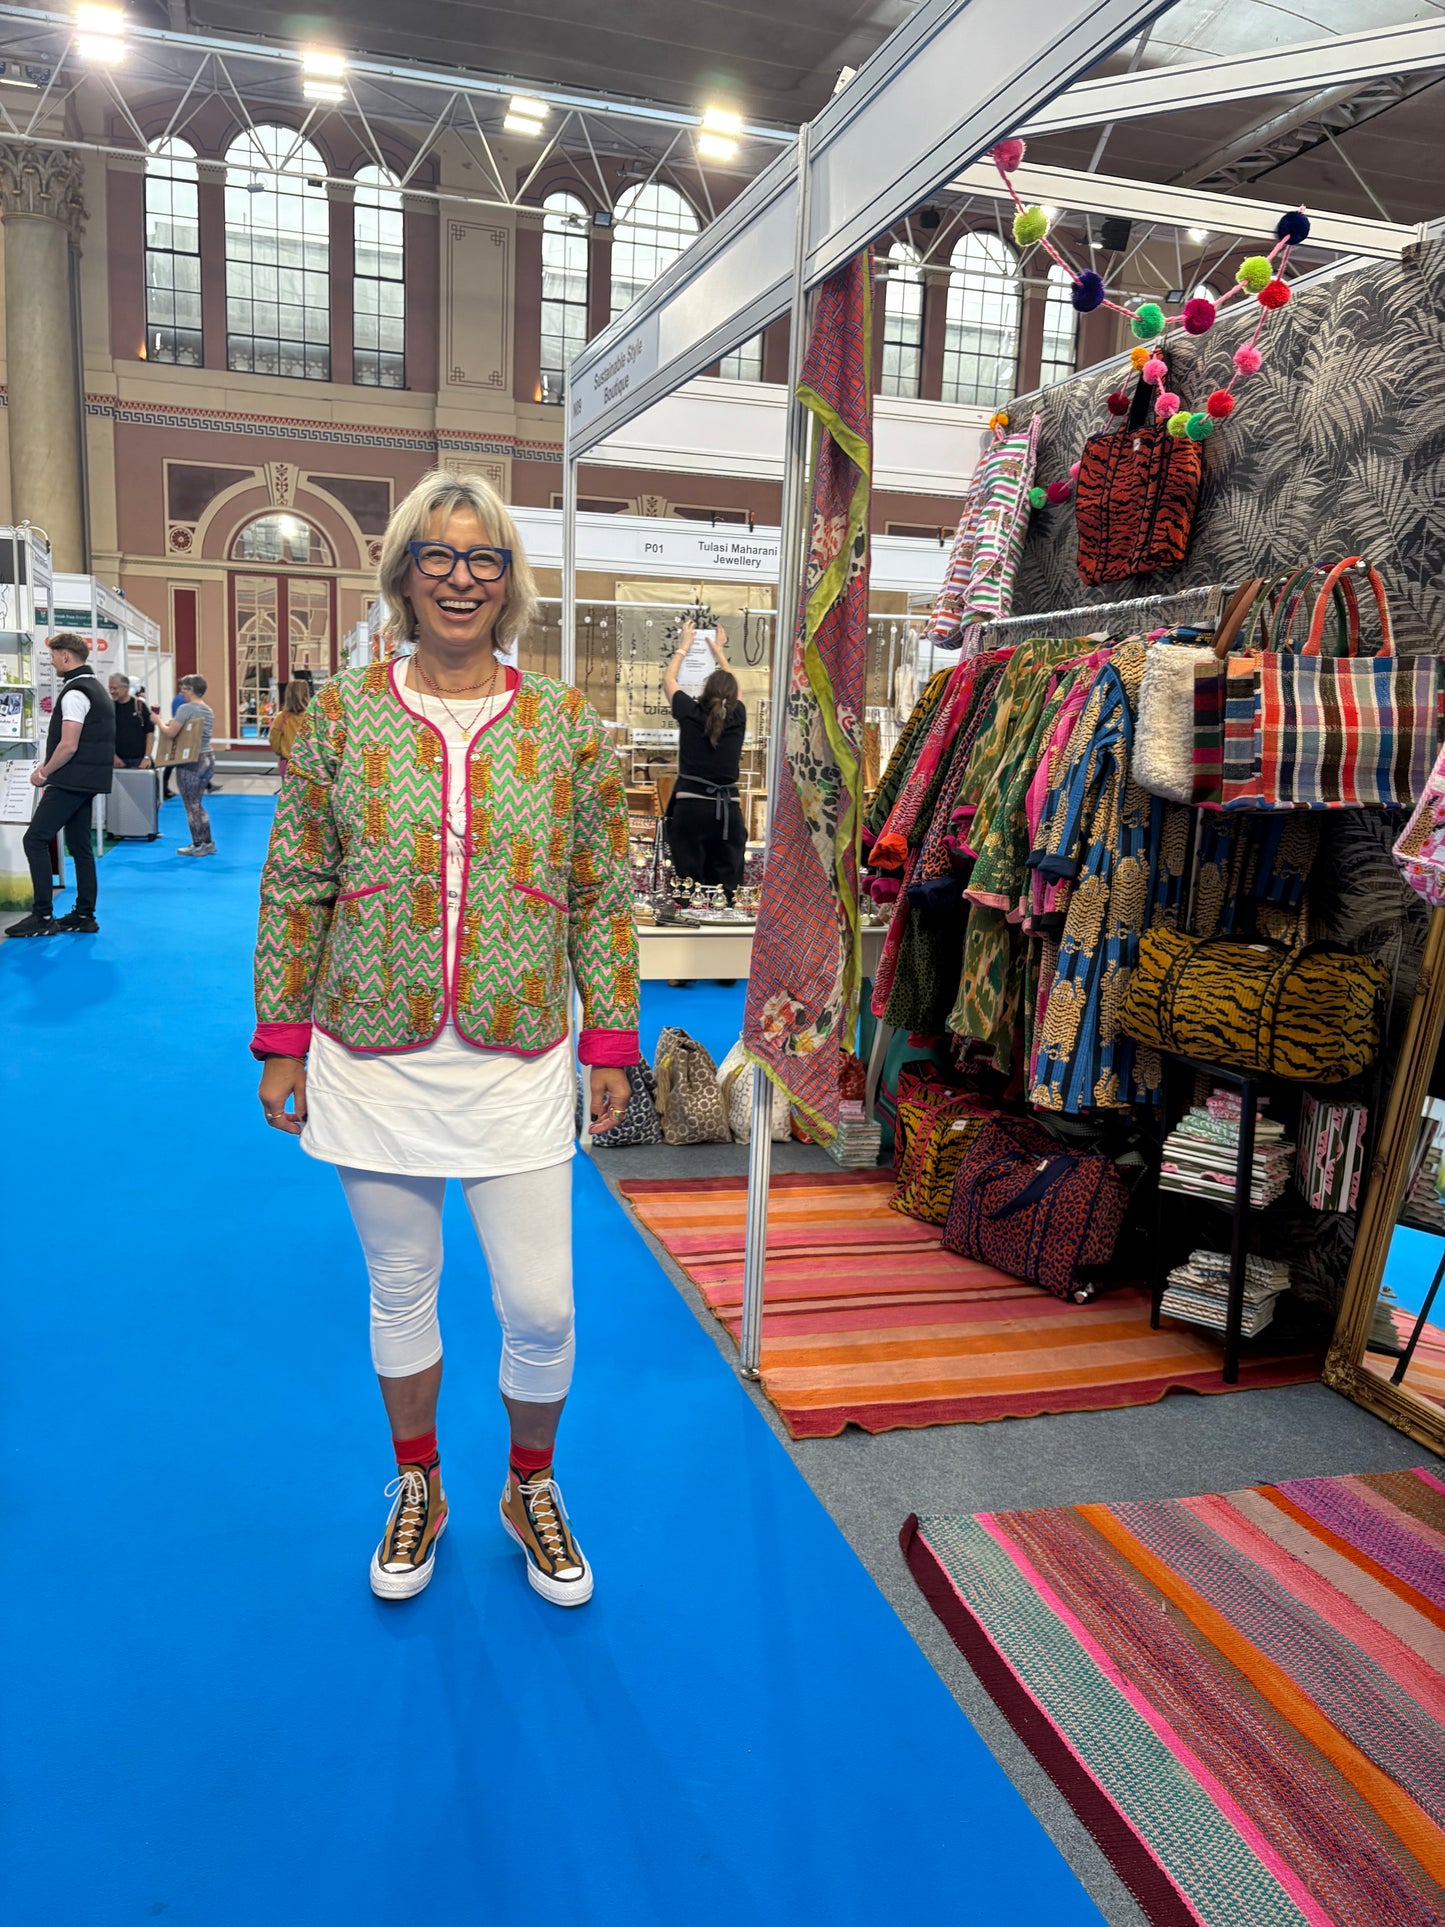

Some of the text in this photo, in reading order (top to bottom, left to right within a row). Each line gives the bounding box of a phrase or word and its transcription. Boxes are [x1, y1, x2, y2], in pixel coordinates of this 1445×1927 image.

[594, 338, 643, 391] Sustainable Style
[604, 374, 630, 404] Boutique
[645, 543, 664, 554] P01
[698, 541, 778, 556] Tulasi Maharani
[713, 554, 762, 568] Jewellery
